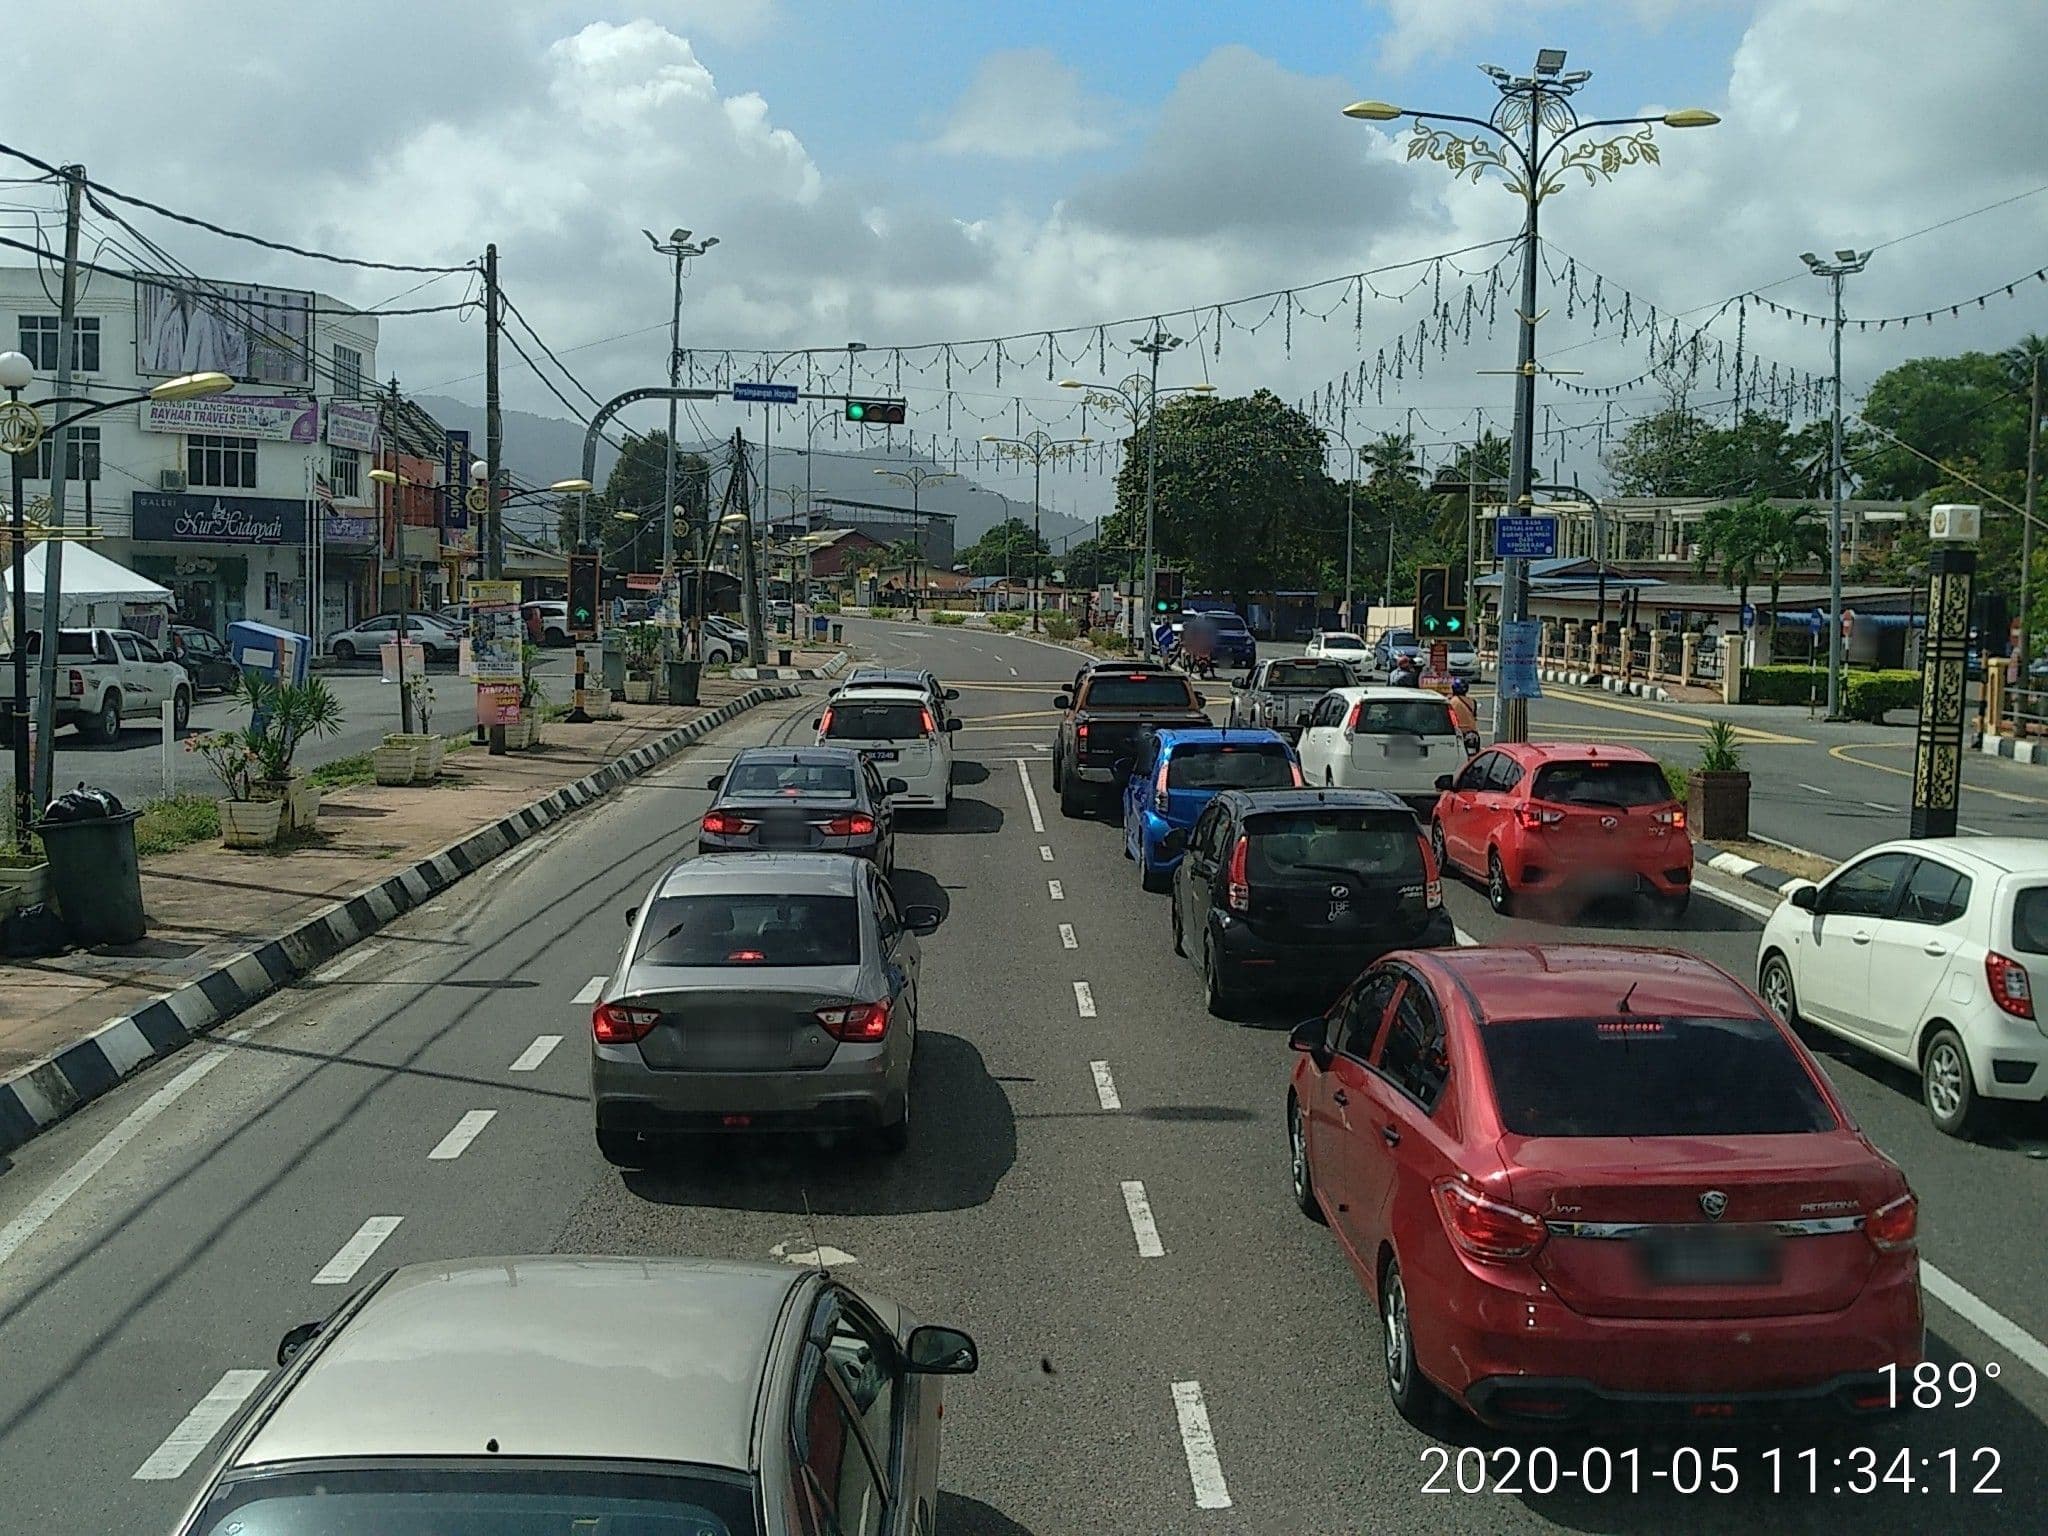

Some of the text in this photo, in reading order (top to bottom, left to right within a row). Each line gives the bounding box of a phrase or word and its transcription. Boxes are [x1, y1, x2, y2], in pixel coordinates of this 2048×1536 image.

[774, 389, 796, 400] Hospital
[187, 401, 255, 414] PELANCONGAN
[150, 407, 192, 422] RAYHAR
[194, 410, 236, 425] TRAVELS
[140, 497, 176, 507] GALERI
[174, 508, 282, 543] Nur Hidayah
[1800, 1200, 1860, 1211] PERSONA
